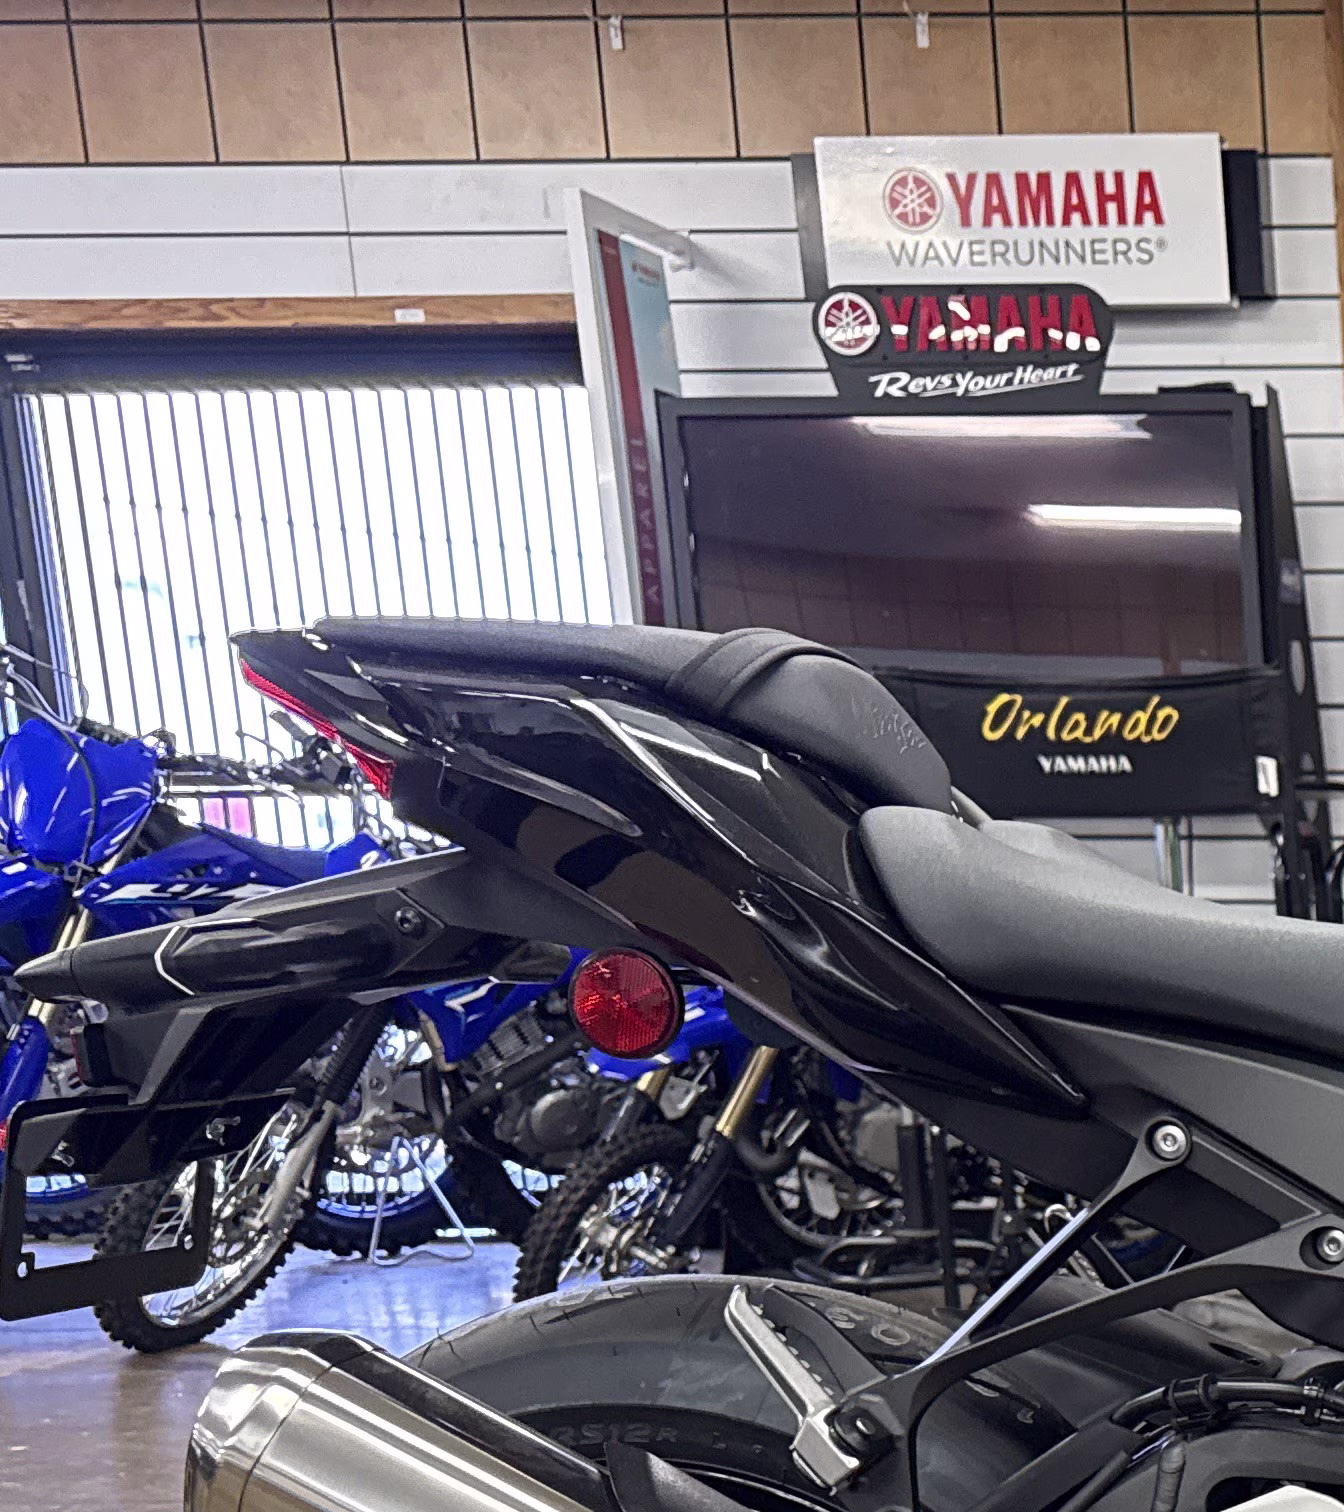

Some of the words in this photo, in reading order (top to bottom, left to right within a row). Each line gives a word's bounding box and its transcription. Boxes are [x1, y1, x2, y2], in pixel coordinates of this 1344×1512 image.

[946, 169, 1165, 229] YAMAHA
[880, 294, 1099, 352] YAMAHA
[868, 371, 953, 398] Revs
[957, 367, 1012, 398] Your
[1012, 362, 1082, 386] Heart
[981, 693, 1181, 744] Orlando
[1038, 755, 1133, 775] YAMAHA
